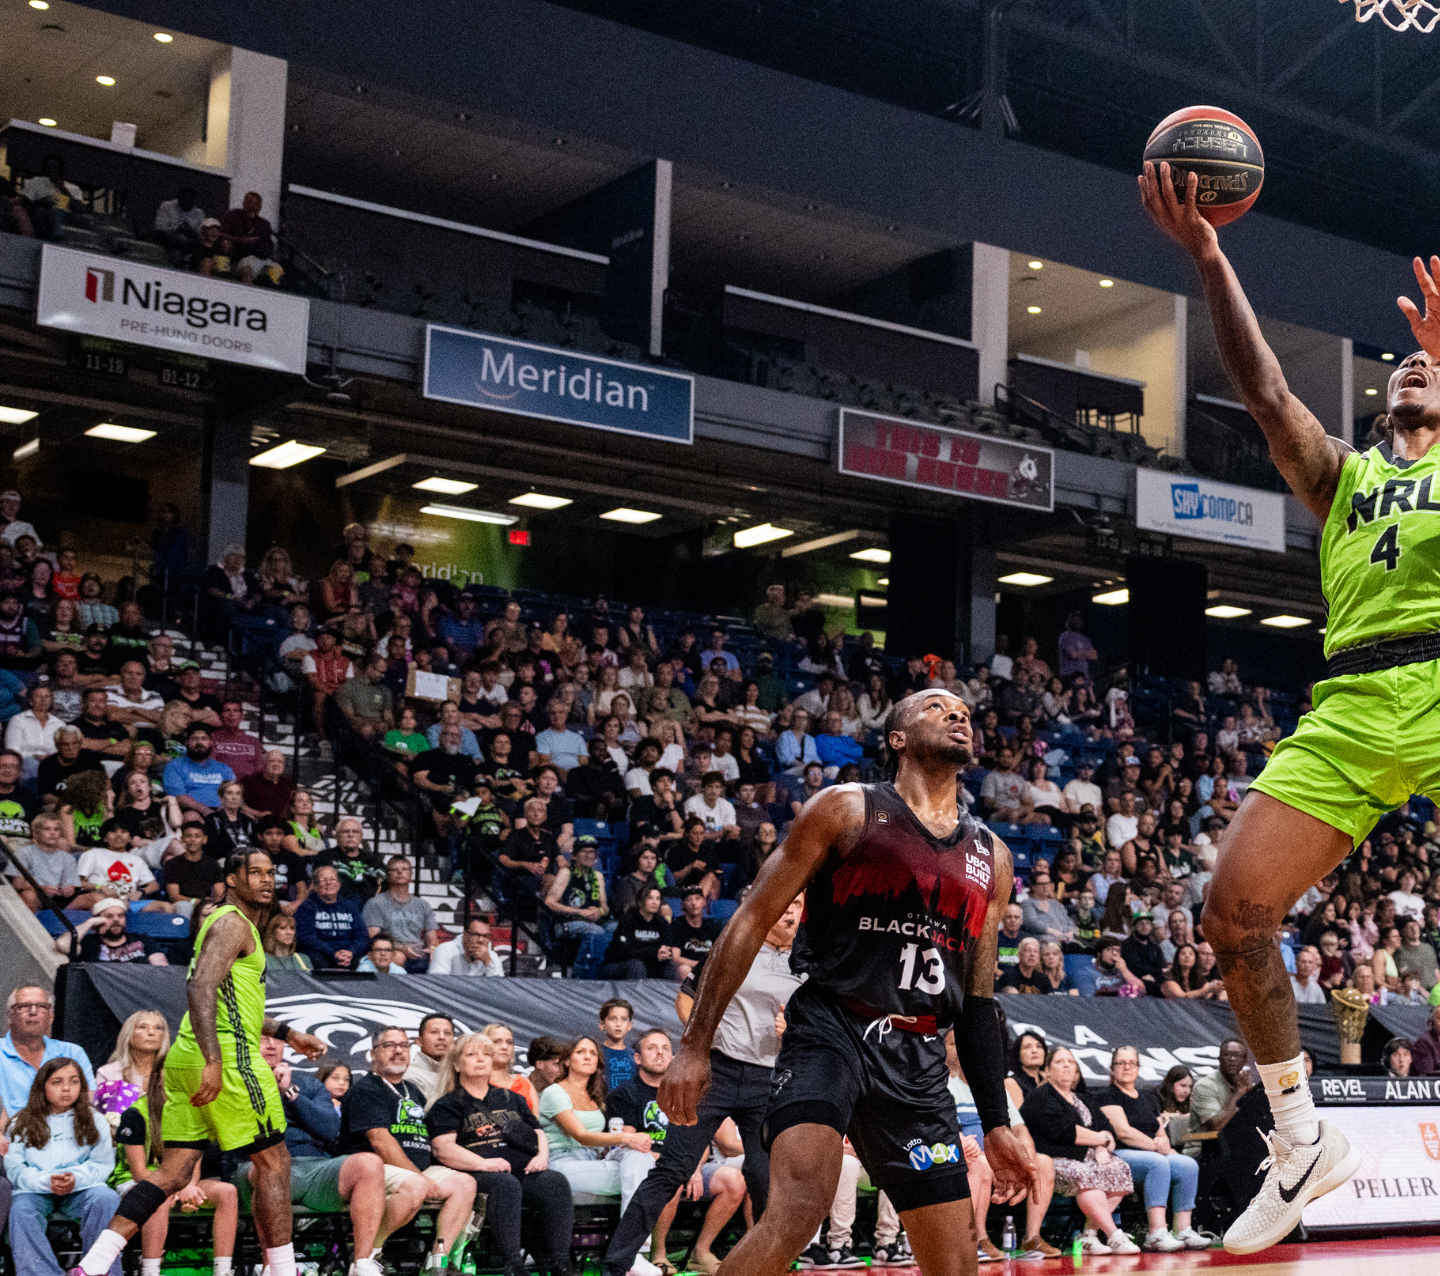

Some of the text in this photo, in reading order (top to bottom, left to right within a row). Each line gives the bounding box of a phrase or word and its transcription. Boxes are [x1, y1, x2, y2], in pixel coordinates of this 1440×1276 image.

[1172, 137, 1247, 158] LEGACY
[123, 278, 267, 332] Niagara
[120, 318, 198, 344] PRE-HUNG
[202, 335, 252, 353] DOORS
[481, 348, 648, 412] Meridian
[1369, 521, 1402, 573] 4
[965, 864, 991, 884] BUILT
[898, 942, 946, 995] 13
[1321, 1079, 1366, 1096] REVEL
[1385, 1080, 1430, 1100] ALAN
[902, 1138, 922, 1151] Lotto
[909, 1142, 959, 1171] MAX
[1353, 1177, 1438, 1199] PELLER
